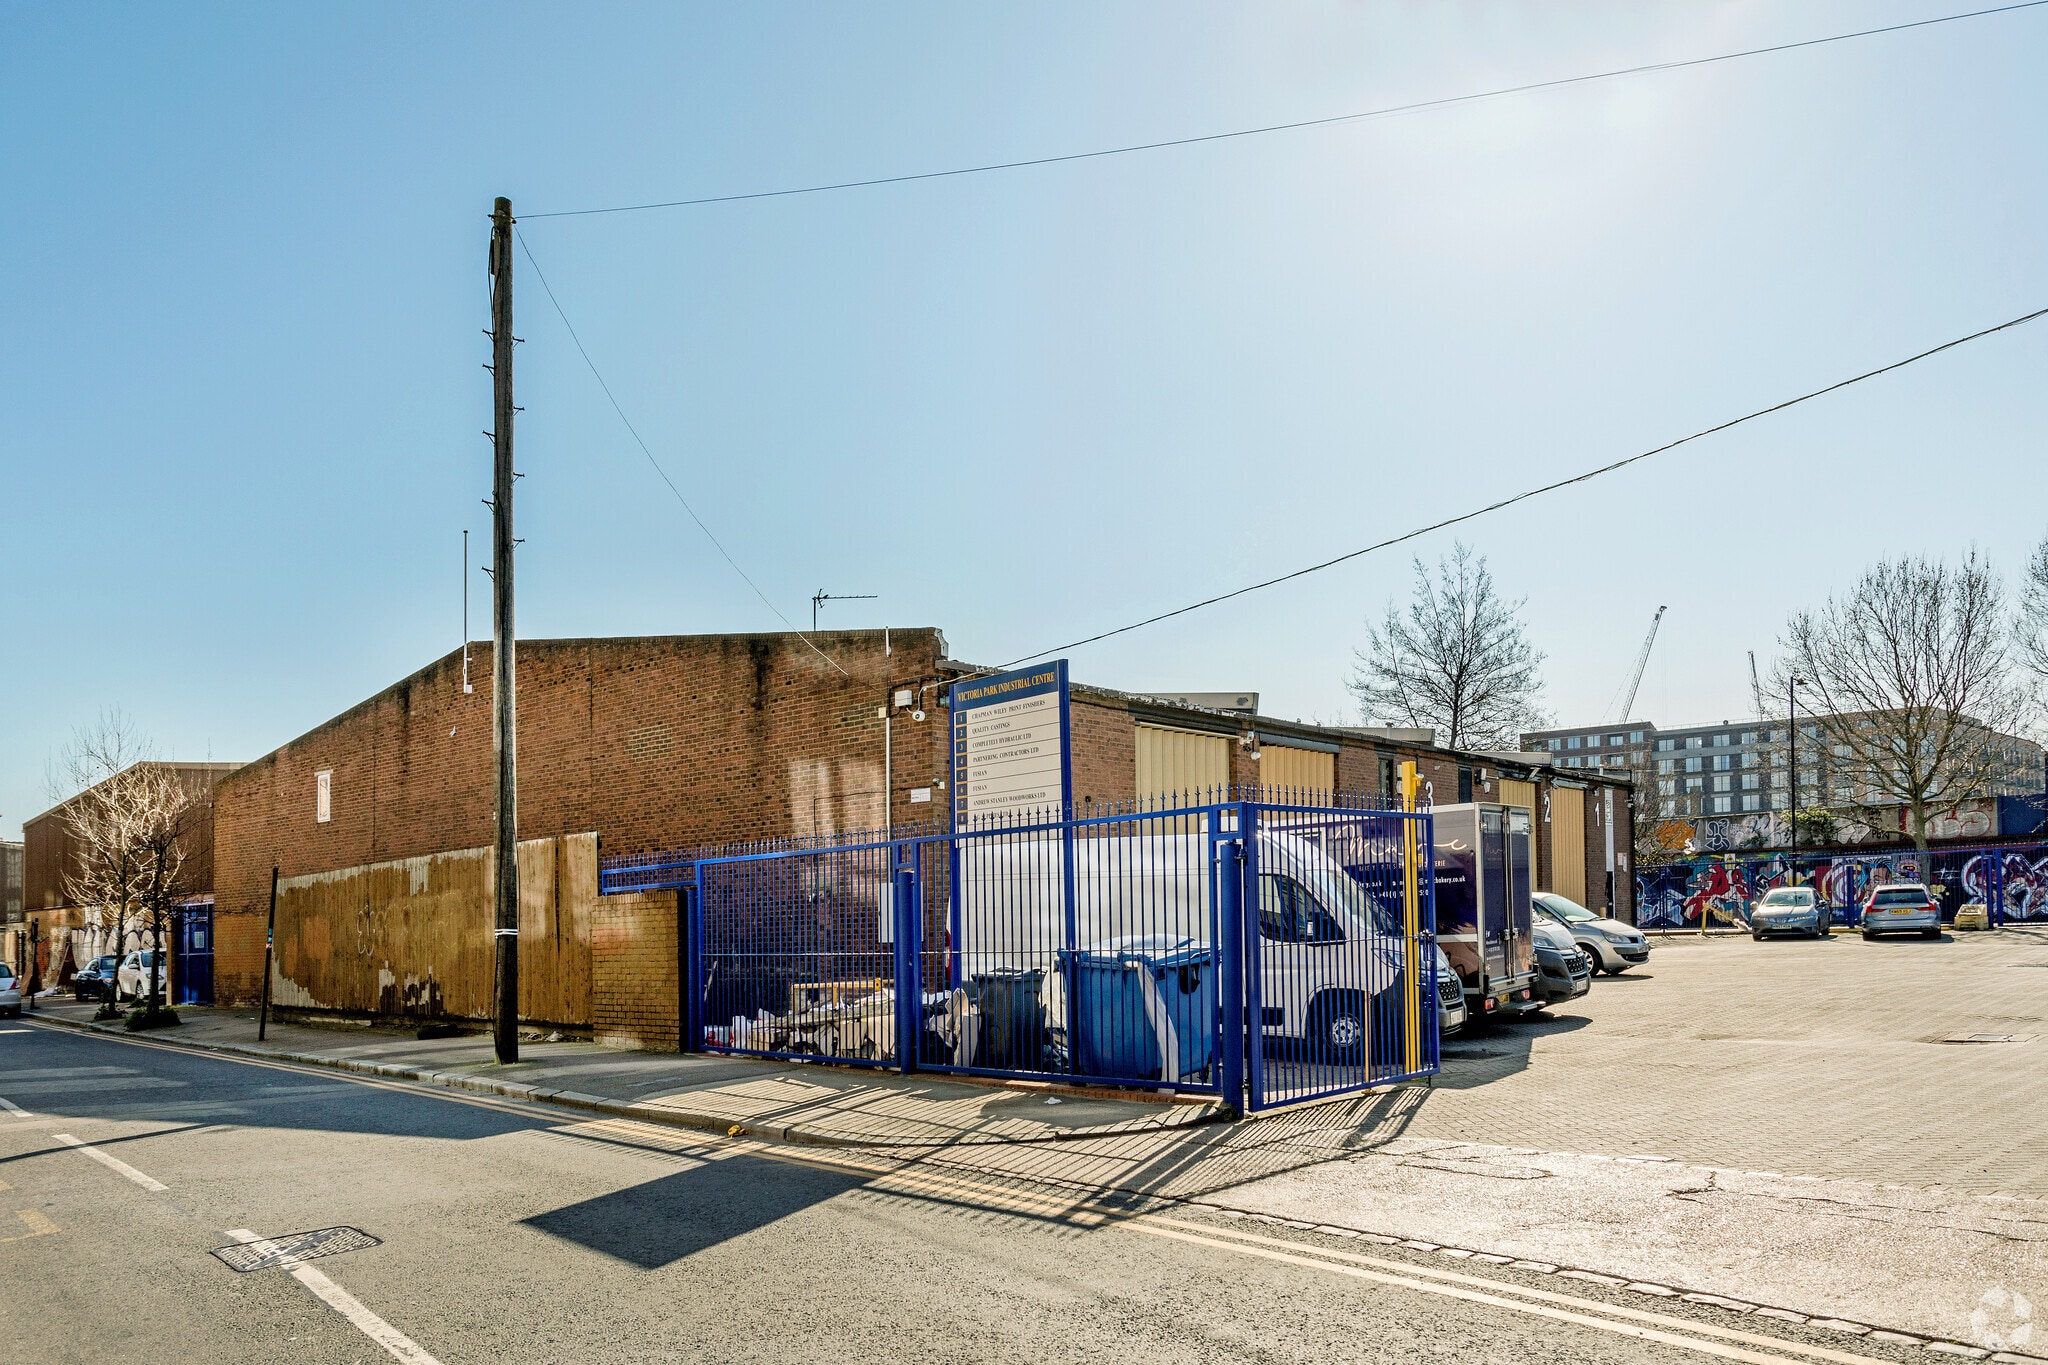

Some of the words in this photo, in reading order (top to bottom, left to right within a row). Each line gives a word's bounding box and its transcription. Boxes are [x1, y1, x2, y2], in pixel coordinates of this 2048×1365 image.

[957, 688, 983, 702] VICTORIA
[983, 685, 998, 696] PARK
[998, 678, 1031, 693] INDUSTRIAL
[1031, 672, 1055, 685] CENTRE
[971, 711, 993, 720] CHAPMAN
[993, 708, 1008, 716] WILEY
[1022, 700, 1046, 710] FINISHERS
[971, 726, 989, 735] QUALITY
[990, 722, 1011, 730] CASTINGS
[972, 739, 998, 748] COMPLETELY
[999, 735, 1023, 744] HYDRAULIC
[972, 754, 998, 763] PARTNERING
[999, 749, 1030, 758] CONTRACTORS
[973, 798, 990, 806] ANDREW
[990, 796, 1008, 804] STANLEY
[1008, 794, 1037, 802] WOODWORKS
[1425, 781, 1434, 808] 3
[1544, 797, 1551, 822] 2
[1595, 803, 1600, 827] 1
